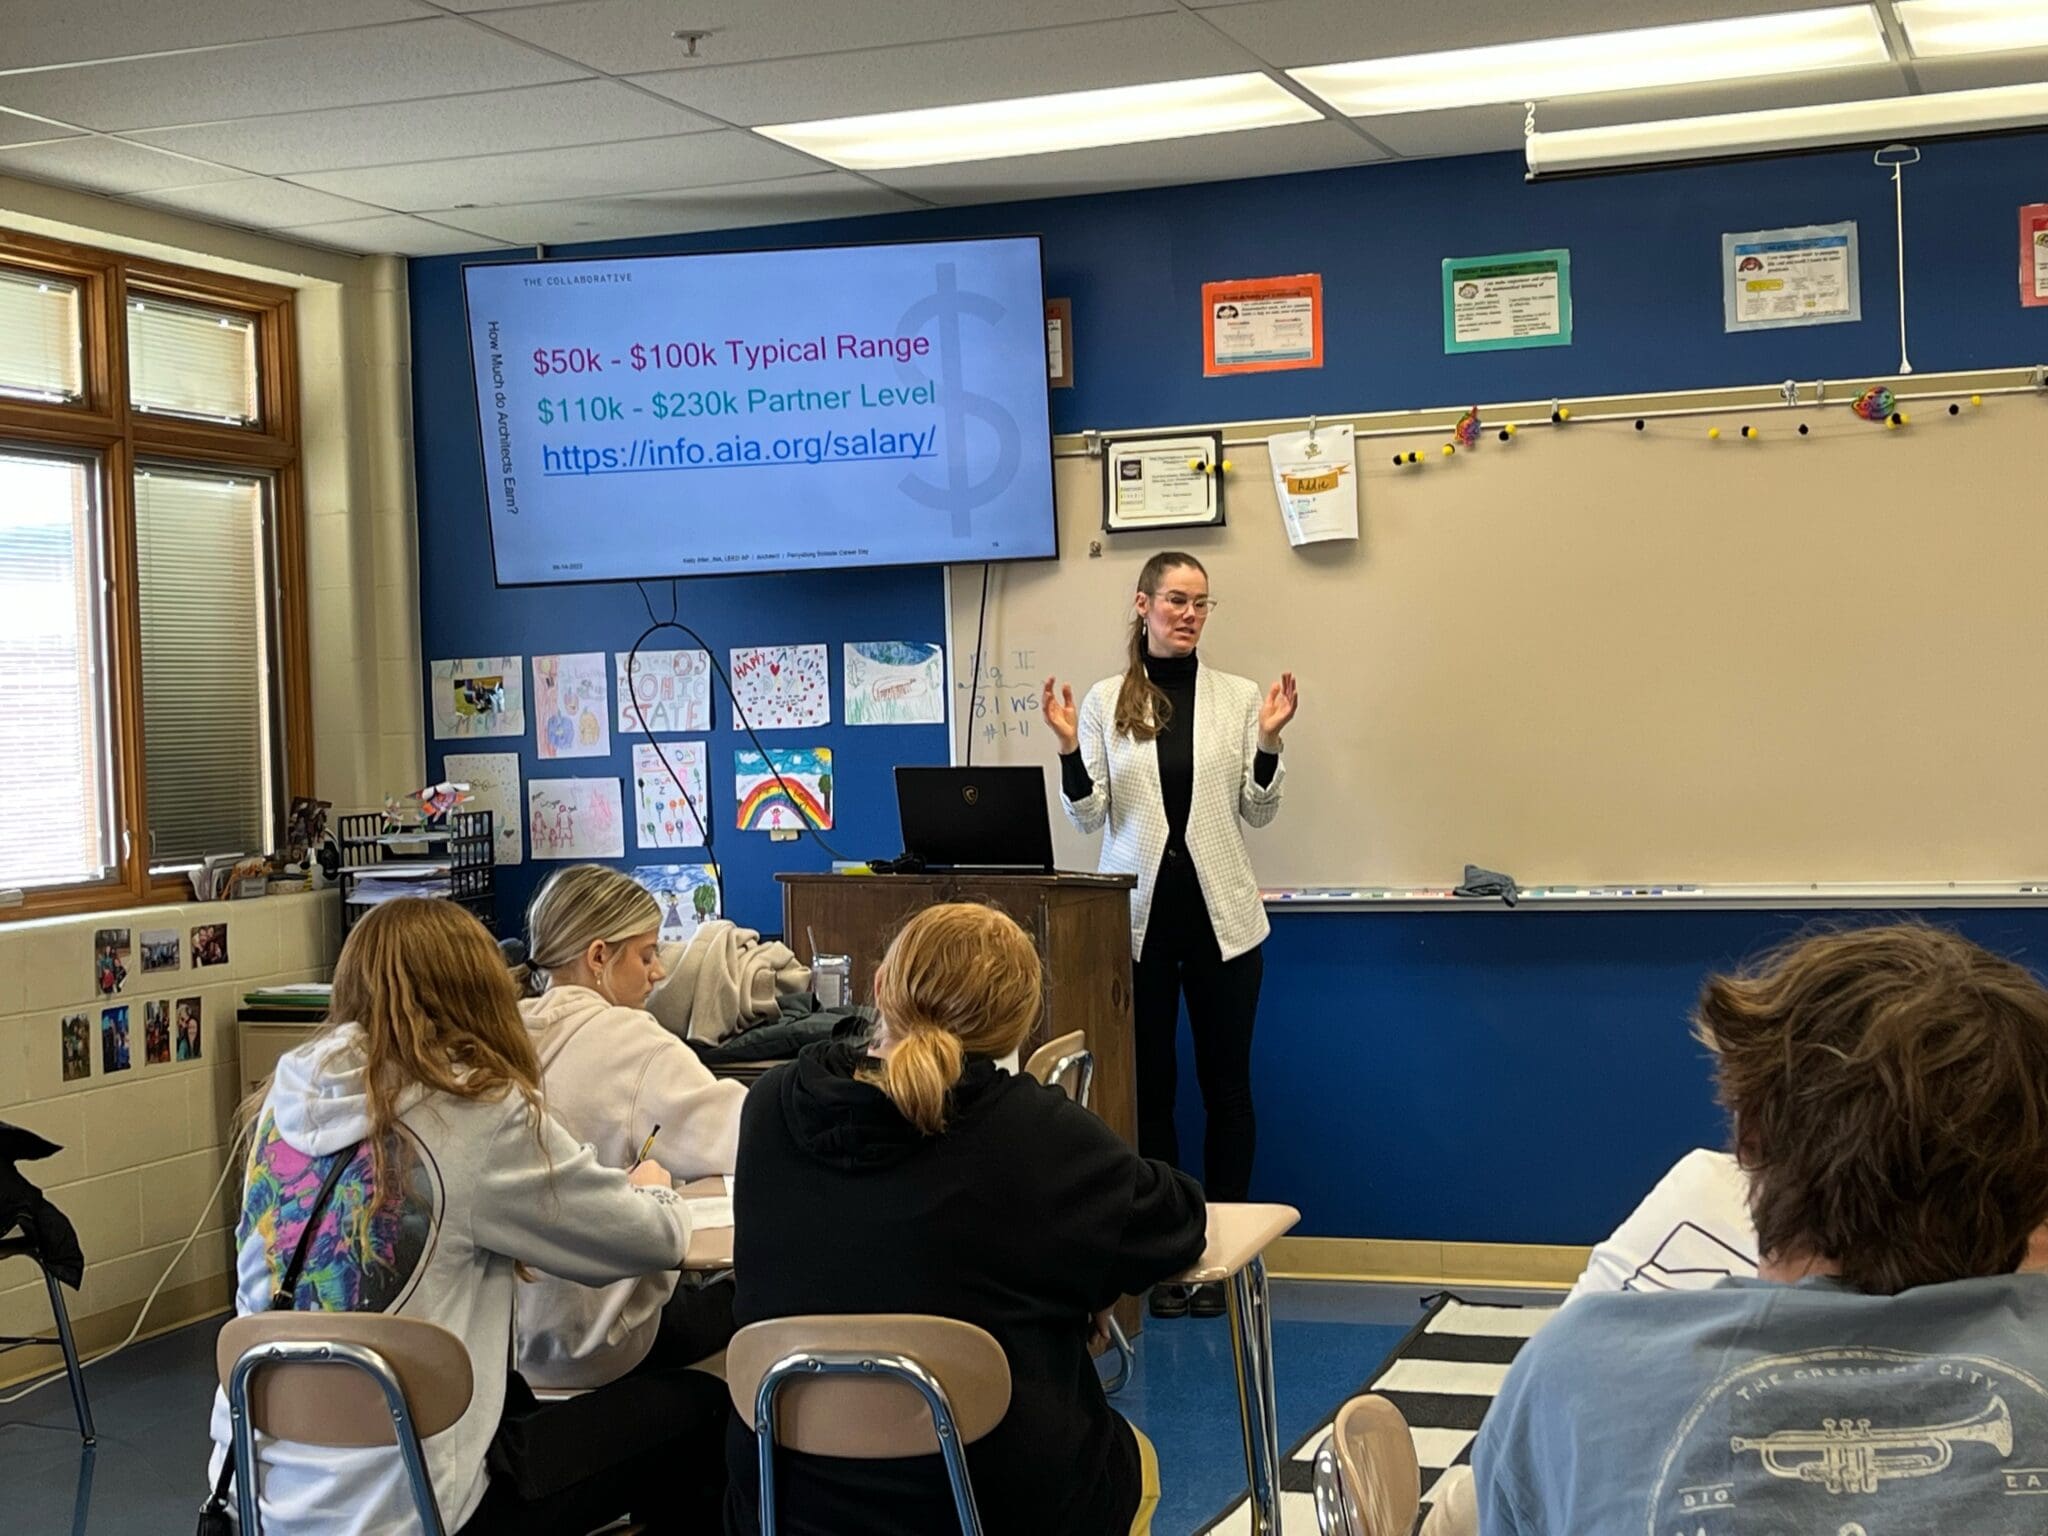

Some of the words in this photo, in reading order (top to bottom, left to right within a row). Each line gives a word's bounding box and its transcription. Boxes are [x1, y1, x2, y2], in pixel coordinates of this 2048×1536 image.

[524, 278, 542, 287] THE
[546, 272, 632, 286] COLLABORATIVE
[488, 321, 499, 350] How
[490, 353, 504, 389] Much
[533, 347, 603, 377] $50k
[630, 342, 717, 372] $100k
[724, 336, 826, 371] Typical
[837, 334, 930, 363] Range
[495, 391, 506, 408] do
[538, 396, 625, 425] $110k
[652, 390, 739, 420] $230k
[748, 388, 851, 414] Partner
[861, 379, 936, 408] Level
[498, 411, 512, 474] Architects
[543, 424, 938, 476] https://info.aia.org/salary/
[504, 477, 519, 515] Earn?
[1298, 478, 1329, 491] Addie
[638, 673, 706, 701] OHIO
[1011, 693, 1039, 713] WS
[622, 700, 705, 732] STATE
[1735, 1372, 1779, 1402] THE
[1794, 1362, 1924, 1381] CRESCENT
[1938, 1364, 1998, 1393] CITY
[1683, 1490, 1729, 1508] BIG
